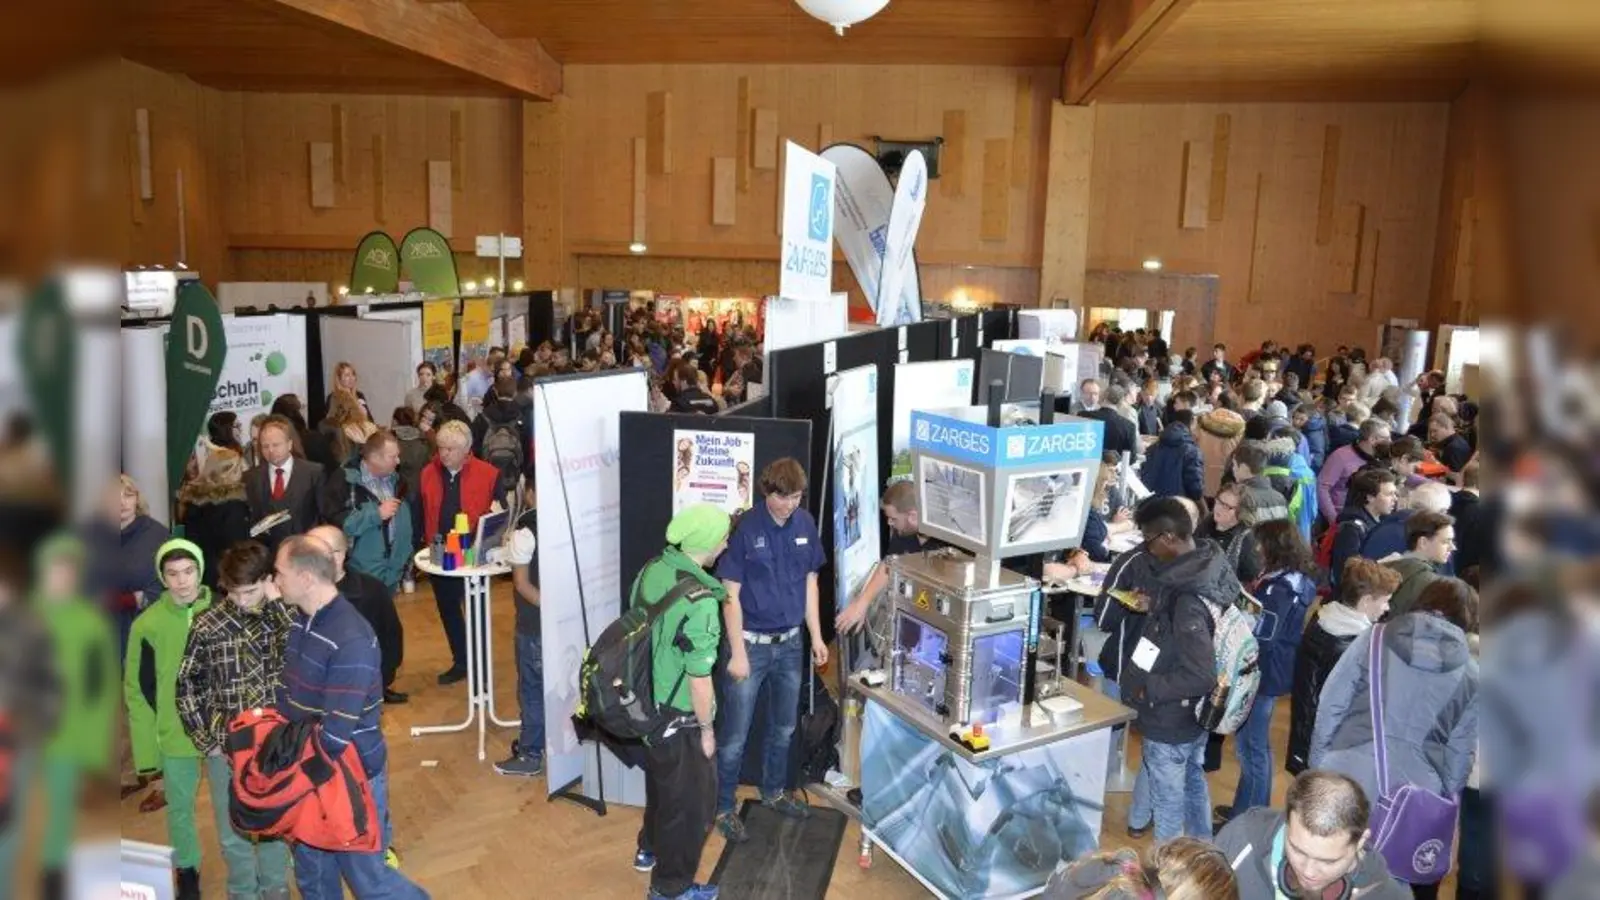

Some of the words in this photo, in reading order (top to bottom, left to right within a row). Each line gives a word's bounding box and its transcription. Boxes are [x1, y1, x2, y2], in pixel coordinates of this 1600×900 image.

[186, 314, 209, 360] D
[695, 433, 721, 446] Mein
[722, 435, 742, 448] Job
[931, 424, 989, 454] ZARGES
[1027, 431, 1096, 455] ZARGES
[699, 445, 730, 457] Meine
[695, 455, 735, 467] Zukunft
